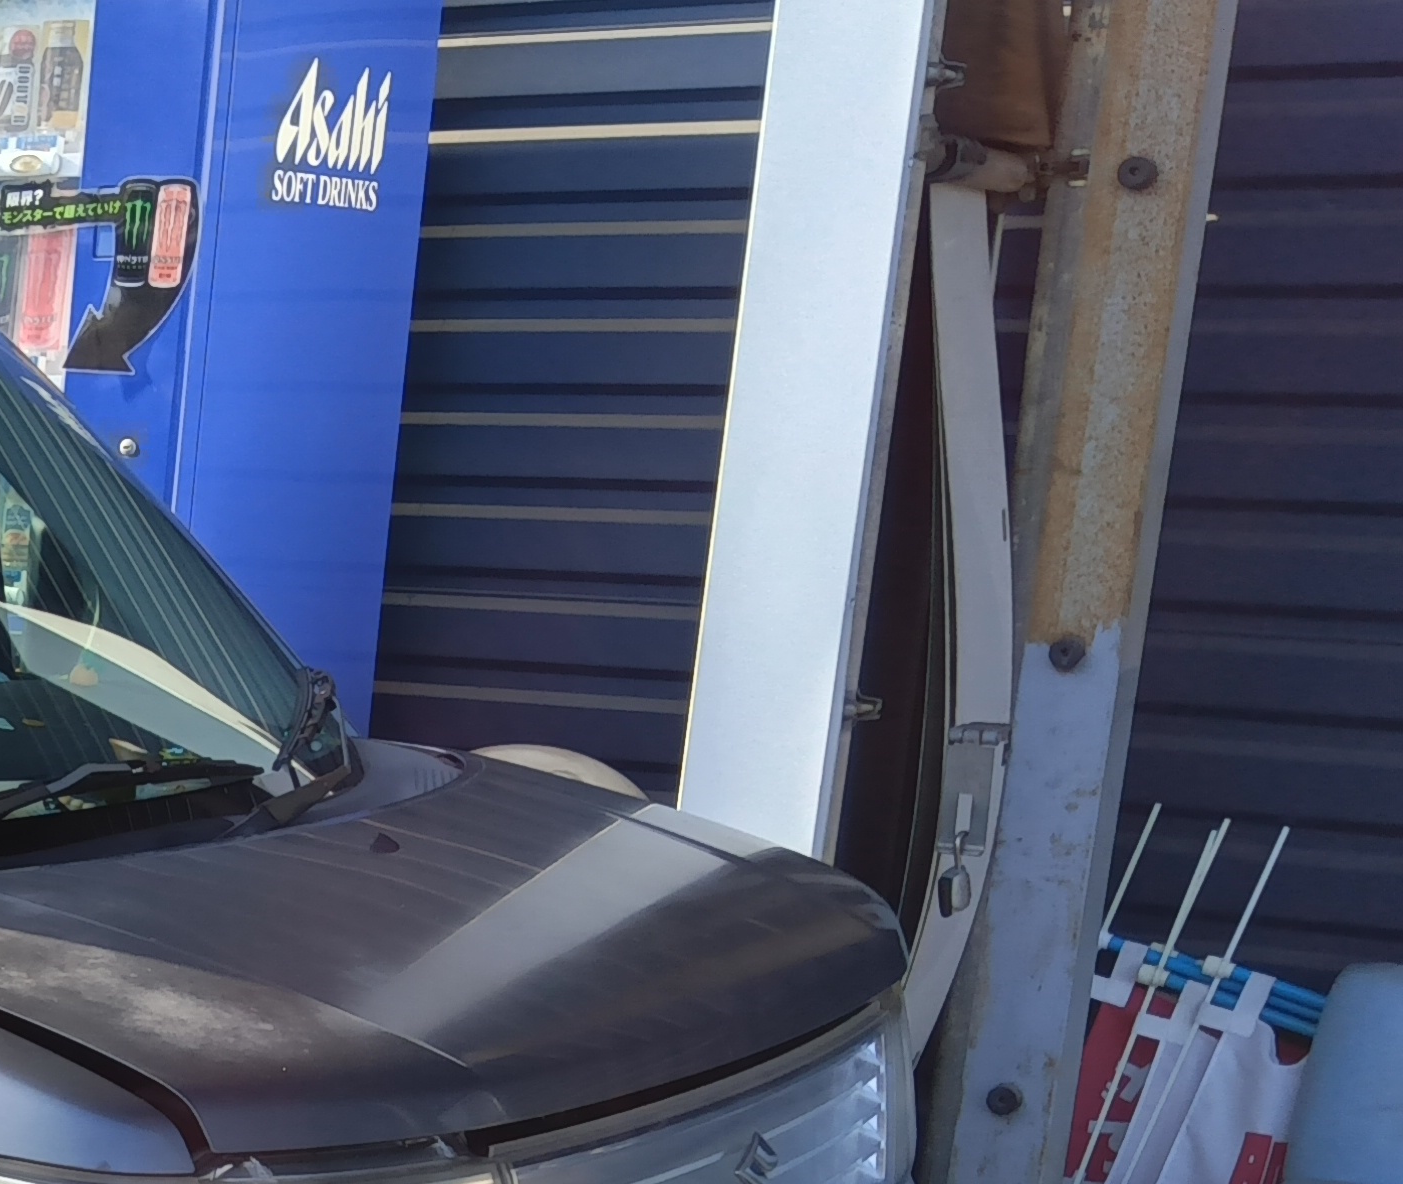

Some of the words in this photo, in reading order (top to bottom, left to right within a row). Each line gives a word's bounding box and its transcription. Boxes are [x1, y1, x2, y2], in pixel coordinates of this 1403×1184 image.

[275, 56, 393, 175] Asahi
[271, 169, 316, 205] SOFT
[317, 174, 378, 211] DRINKS
